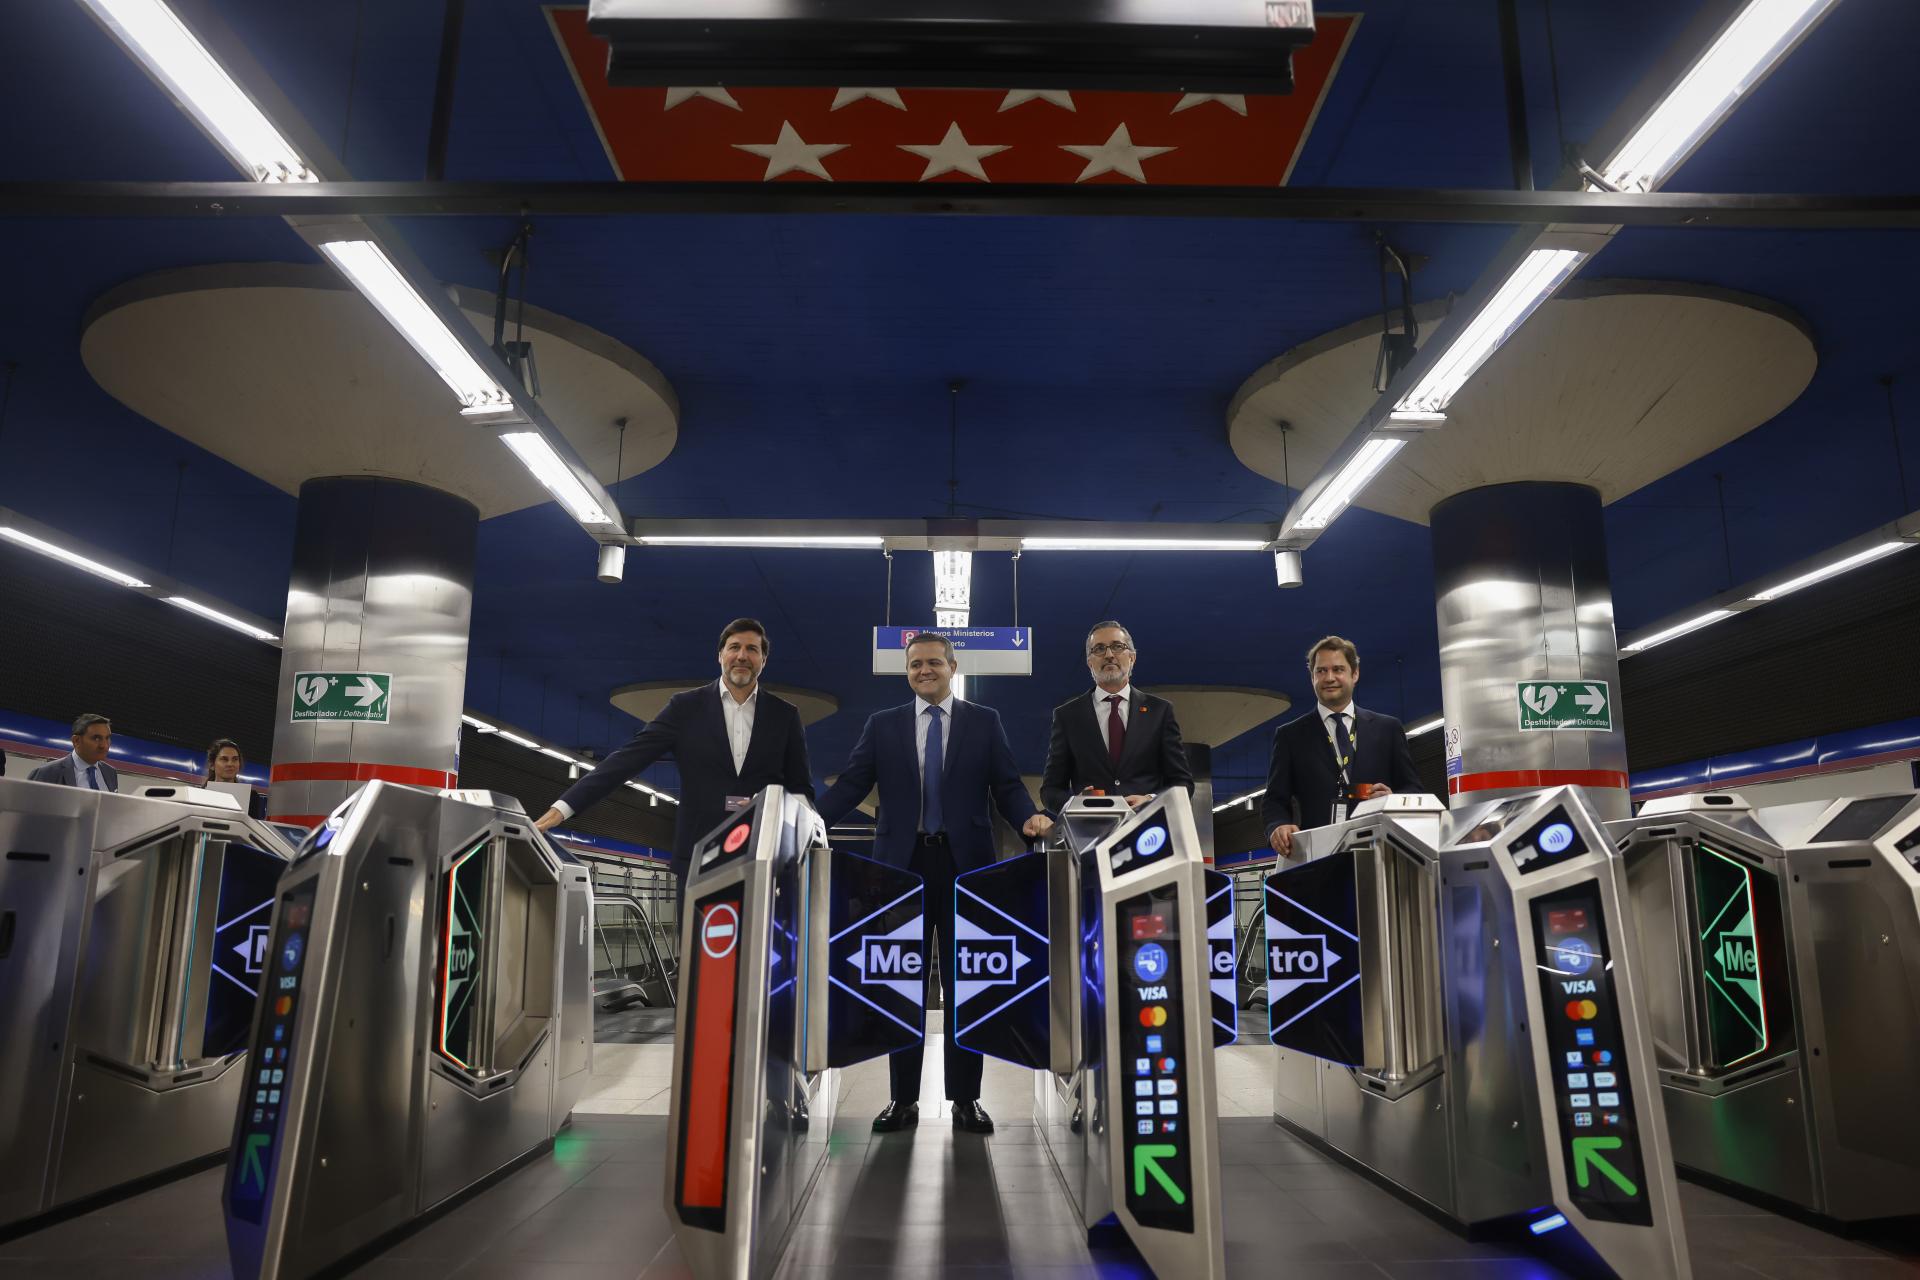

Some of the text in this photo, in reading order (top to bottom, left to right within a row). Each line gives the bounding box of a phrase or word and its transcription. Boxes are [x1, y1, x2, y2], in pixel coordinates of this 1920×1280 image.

[451, 943, 468, 973] tro
[869, 944, 1009, 975] Me tro
[1269, 945, 1319, 974] tro
[1725, 941, 1756, 973] Me
[1137, 986, 1168, 1001] VISA
[1561, 980, 1596, 994] VISA
